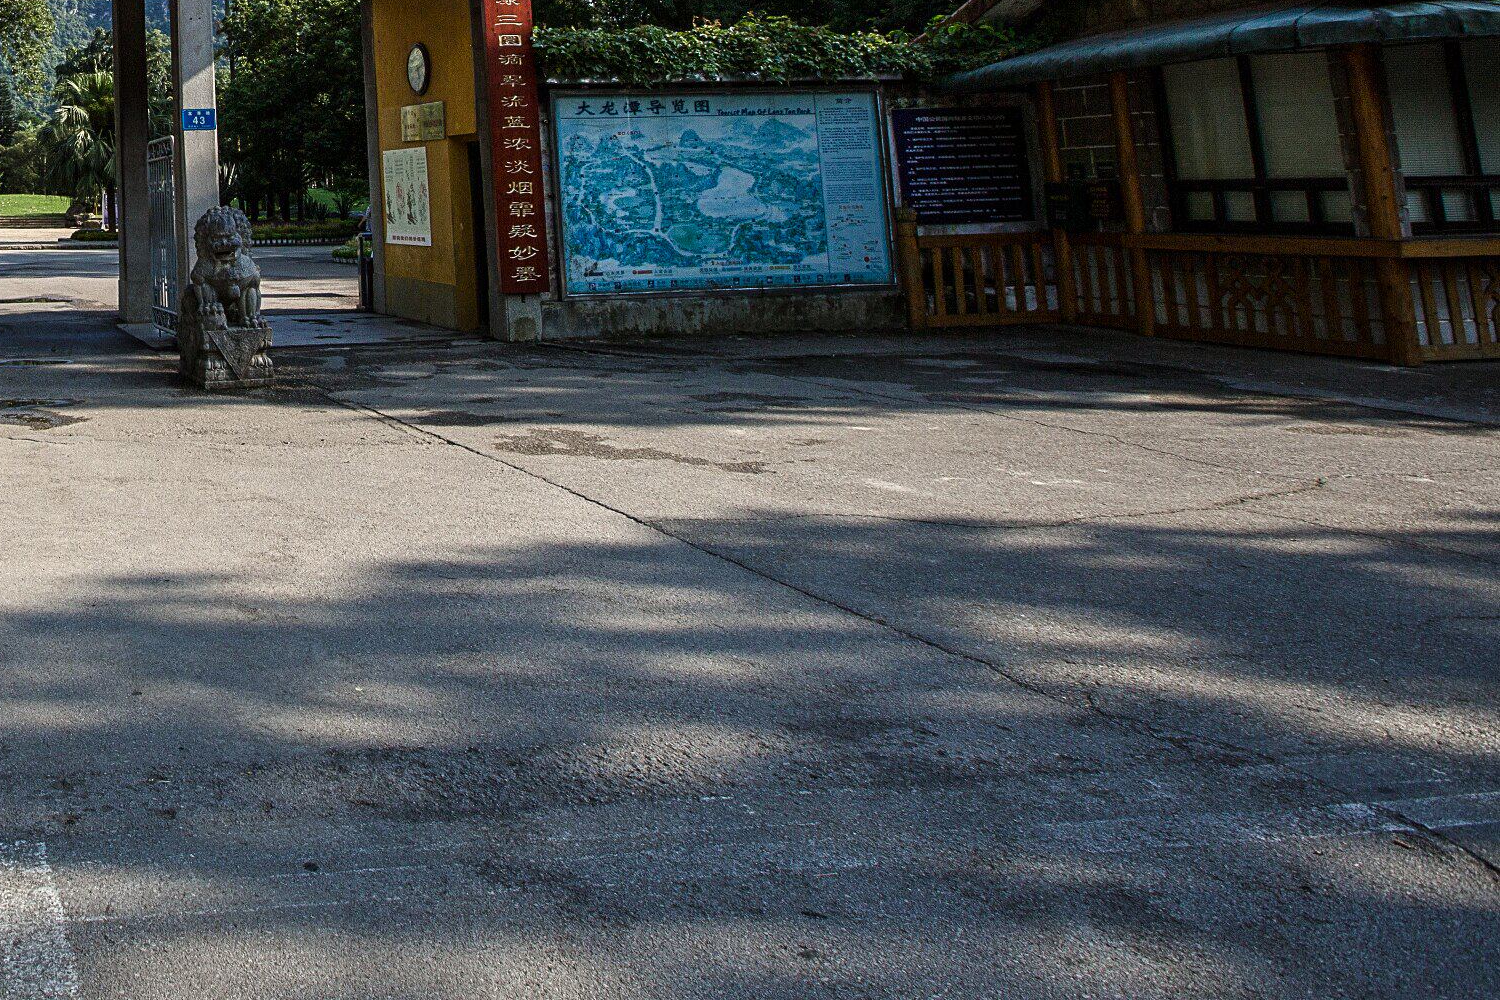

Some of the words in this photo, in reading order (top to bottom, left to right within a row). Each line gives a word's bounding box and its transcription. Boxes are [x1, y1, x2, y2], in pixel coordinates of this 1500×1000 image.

[575, 99, 710, 116] 大龙潭导览图
[741, 107, 756, 115] Map
[192, 116, 206, 124] 43
